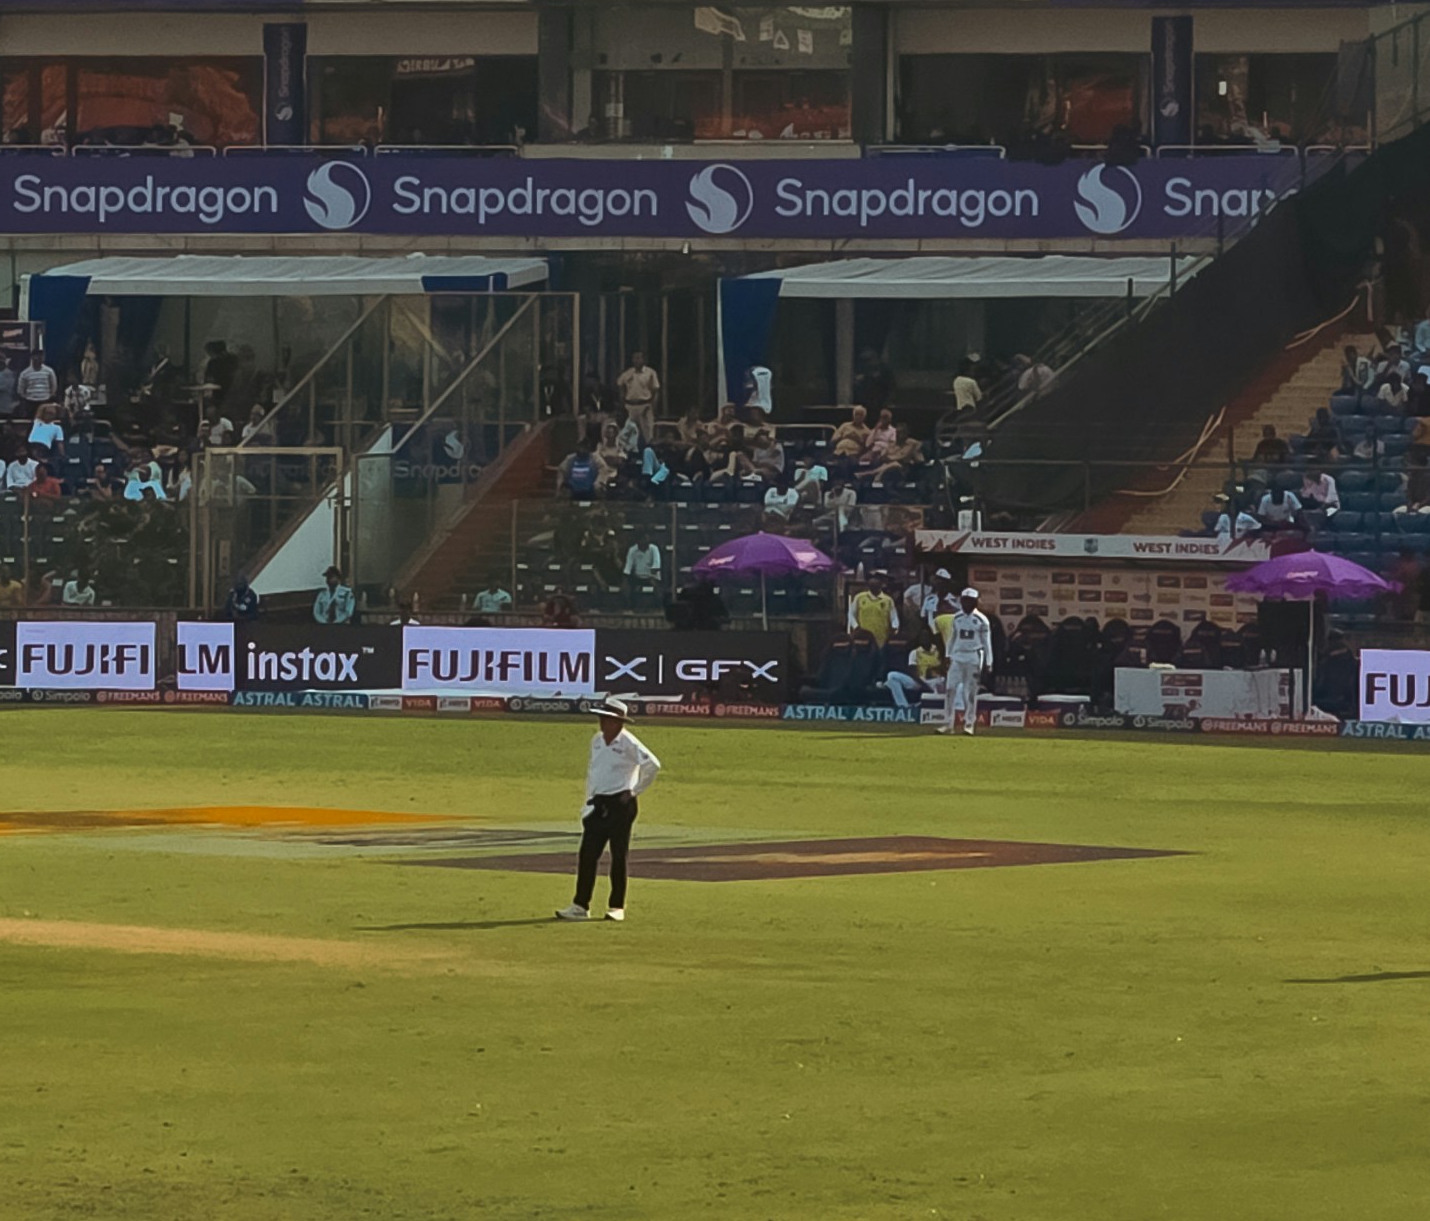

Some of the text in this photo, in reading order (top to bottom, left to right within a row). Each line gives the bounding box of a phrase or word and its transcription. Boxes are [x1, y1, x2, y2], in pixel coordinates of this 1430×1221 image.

[14, 175, 278, 223] Snapdragon
[393, 176, 658, 225] Snapdragon
[775, 177, 1039, 227] Snapdragon
[971, 538, 1056, 551] WEST INDIES
[1133, 542, 1220, 556] WEST INDIES
[408, 649, 591, 683] FUJIFILM
[605, 656, 778, 683] X GFX
[45, 691, 91, 703] Simpolo
[233, 692, 296, 706] ASTRAL
[301, 694, 364, 708] ASTRAL
[523, 699, 570, 712] Simpolo
[783, 706, 846, 720] ASTRAL
[853, 708, 915, 722] ASTRAL
[1029, 716, 1055, 726] VIDA
[1147, 717, 1194, 730] Simpolo
[1341, 722, 1407, 738] ASTRAL
